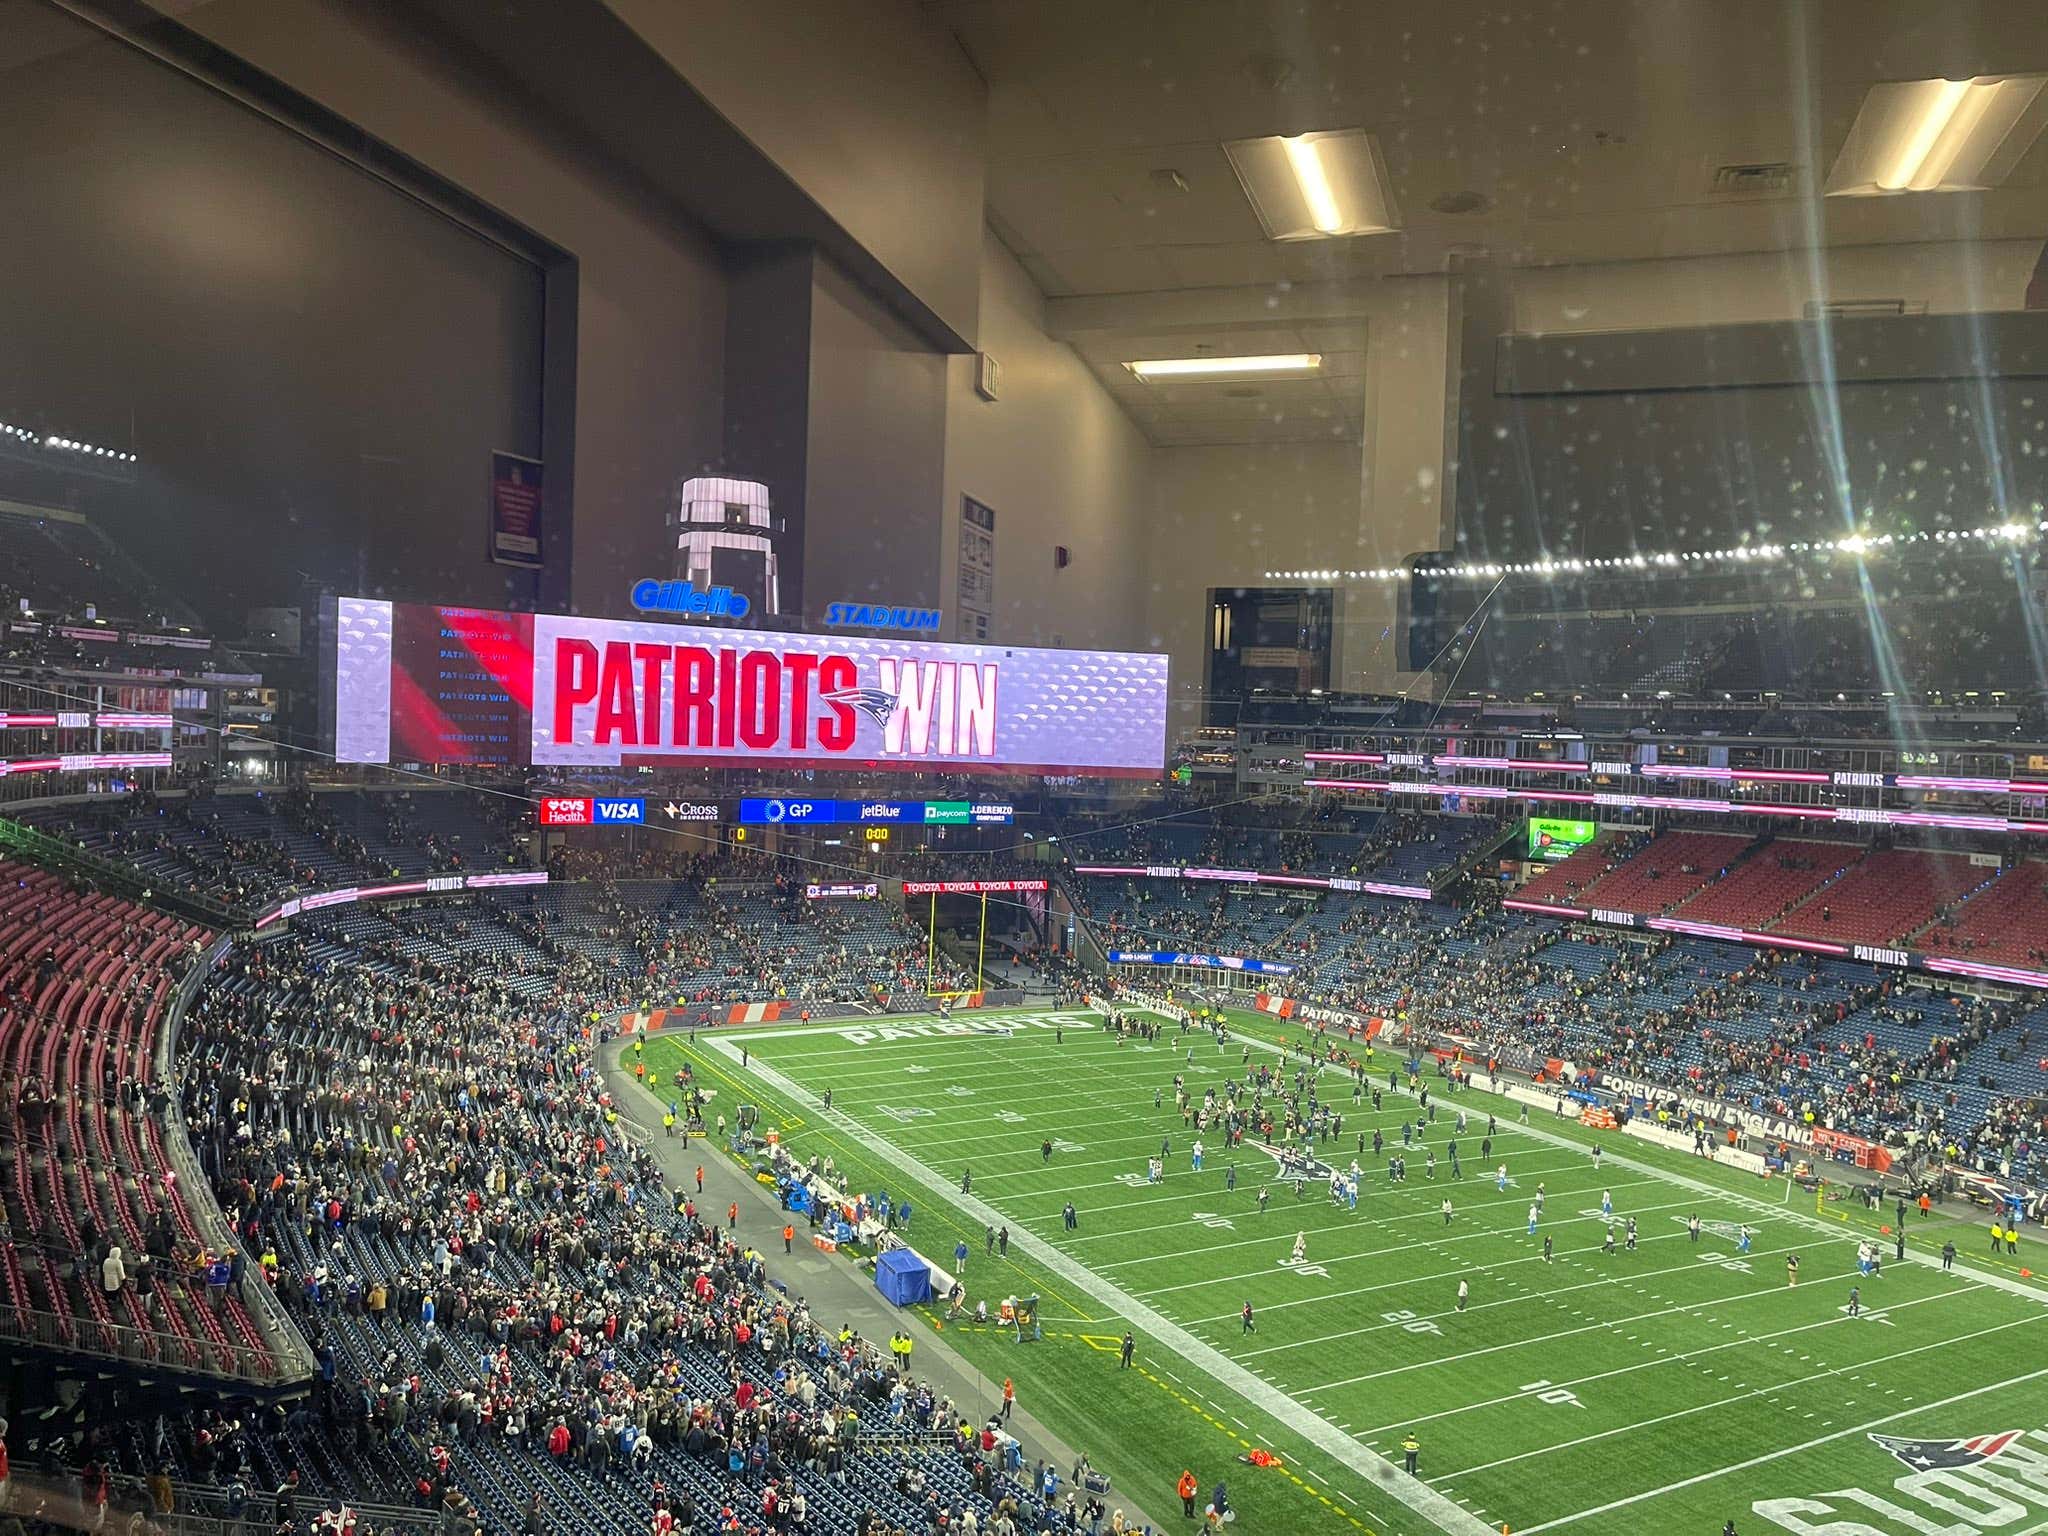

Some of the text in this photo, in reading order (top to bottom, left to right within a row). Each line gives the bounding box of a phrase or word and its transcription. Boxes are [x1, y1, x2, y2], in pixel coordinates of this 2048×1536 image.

[632, 579, 750, 617] Gillette
[825, 602, 943, 631] STADIUM
[440, 691, 509, 702] PATRIOTS WIN
[553, 637, 998, 757] PATRIOTS WIN
[58, 713, 91, 728] PATRIOTS
[489, 735, 508, 743] WIN
[1386, 753, 1424, 765] PATRIOTS
[1592, 762, 1632, 774] PATRIOTS
[1834, 771, 1883, 786] PATRIOTS
[559, 801, 585, 811] CVS
[597, 804, 640, 819] VISA
[680, 802, 718, 815] CROSS
[861, 804, 900, 819] jetBlue
[549, 811, 585, 823] Health
[936, 810, 966, 818] paycom
[737, 828, 746, 840] 0
[866, 828, 888, 840] 0:00
[1146, 866, 1180, 878] PATRIOTS
[426, 876, 463, 891] PATRIOTS
[907, 881, 1045, 892] TOYOTA TOYOTA TOYOTA TOYOTA
[1329, 878, 1361, 891] PATRIOTS
[1591, 908, 1635, 926] PATRIOTS
[1853, 944, 1908, 967] PATRIOTS
[838, 1016, 1096, 1045] PATRIOTS
[1601, 1074, 1815, 1145] FOREVER NEW ENGLAND
[1192, 1212, 1232, 1228] 40
[1380, 1309, 1438, 1333] 20
[1519, 1379, 1577, 1404] 10
